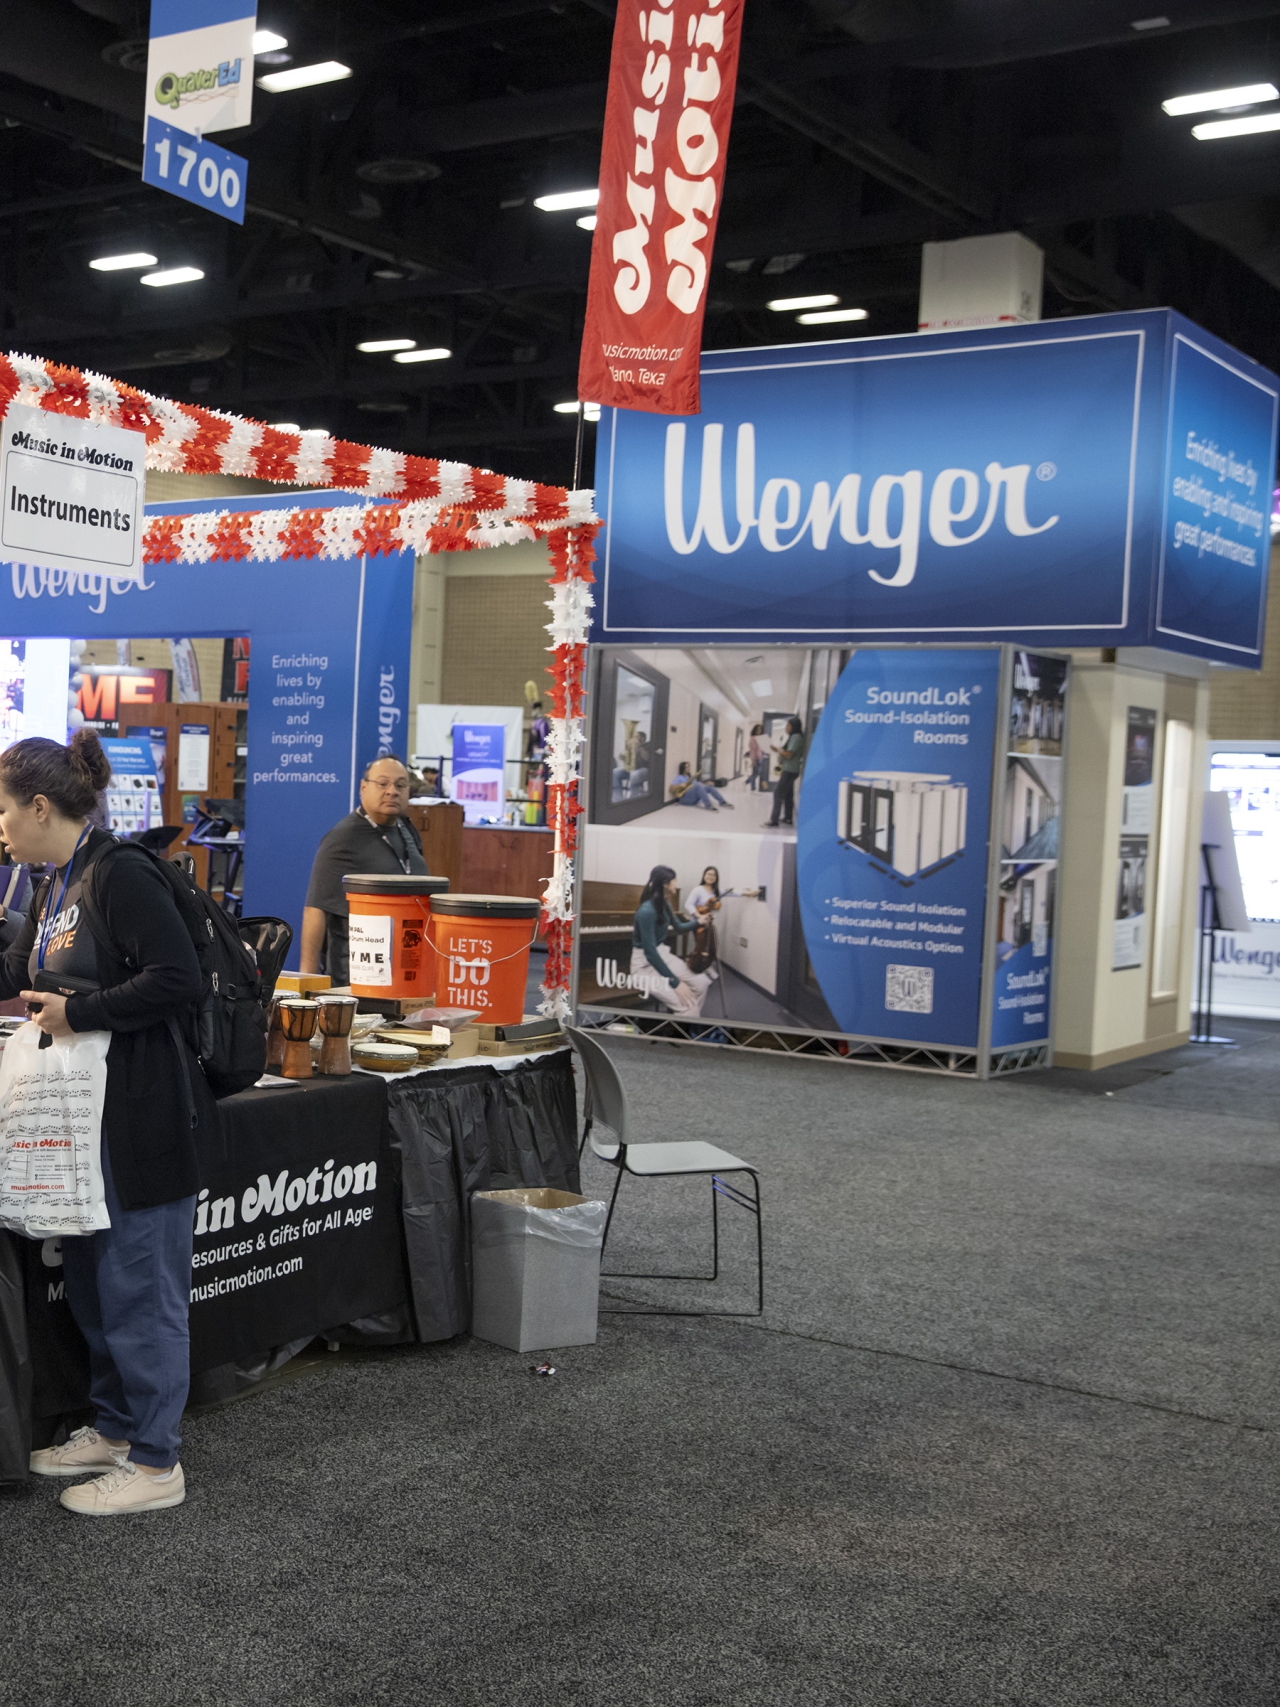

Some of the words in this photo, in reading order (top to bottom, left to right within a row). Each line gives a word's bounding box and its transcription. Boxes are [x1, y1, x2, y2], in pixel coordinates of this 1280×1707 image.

[155, 58, 241, 109] QuaverEd
[155, 138, 240, 208] 1700
[609, 365, 635, 385] lano,
[638, 368, 667, 386] Texa
[11, 430, 59, 456] Music
[60, 442, 75, 461] in
[77, 446, 133, 472] Motion
[11, 485, 131, 532] Instruments
[1173, 520, 1201, 549] great
[272, 653, 329, 670] Enriching
[276, 674, 303, 687] lives
[307, 673, 322, 690] by
[272, 692, 325, 709] enabling
[286, 711, 310, 725] and
[844, 709, 970, 725] Sound-Isolation
[271, 731, 324, 748] inspiring
[913, 729, 969, 745] Rooms
[280, 752, 313, 767] great
[253, 768, 340, 785] performances.
[831, 897, 879, 910] Superior
[880, 900, 916, 913] Sound
[917, 903, 967, 917] Isolation
[830, 914, 893, 930] Relocatable
[894, 920, 917, 932] and
[917, 922, 966, 935] Modular
[46, 930, 77, 957] LOVE
[449, 937, 493, 955] LET'S
[831, 932, 869, 946] Virtual
[870, 936, 923, 951] Acoustics
[924, 940, 965, 954] Option
[448, 955, 491, 986] DO
[447, 986, 493, 1007] THIS.
[194, 1188, 235, 1235] in
[241, 1159, 377, 1223] Motion
[191, 1238, 254, 1269] esources
[256, 1233, 266, 1251] &
[270, 1225, 300, 1247] Gifts
[302, 1217, 322, 1239] for
[323, 1210, 341, 1231] All
[344, 1205, 375, 1227] Age
